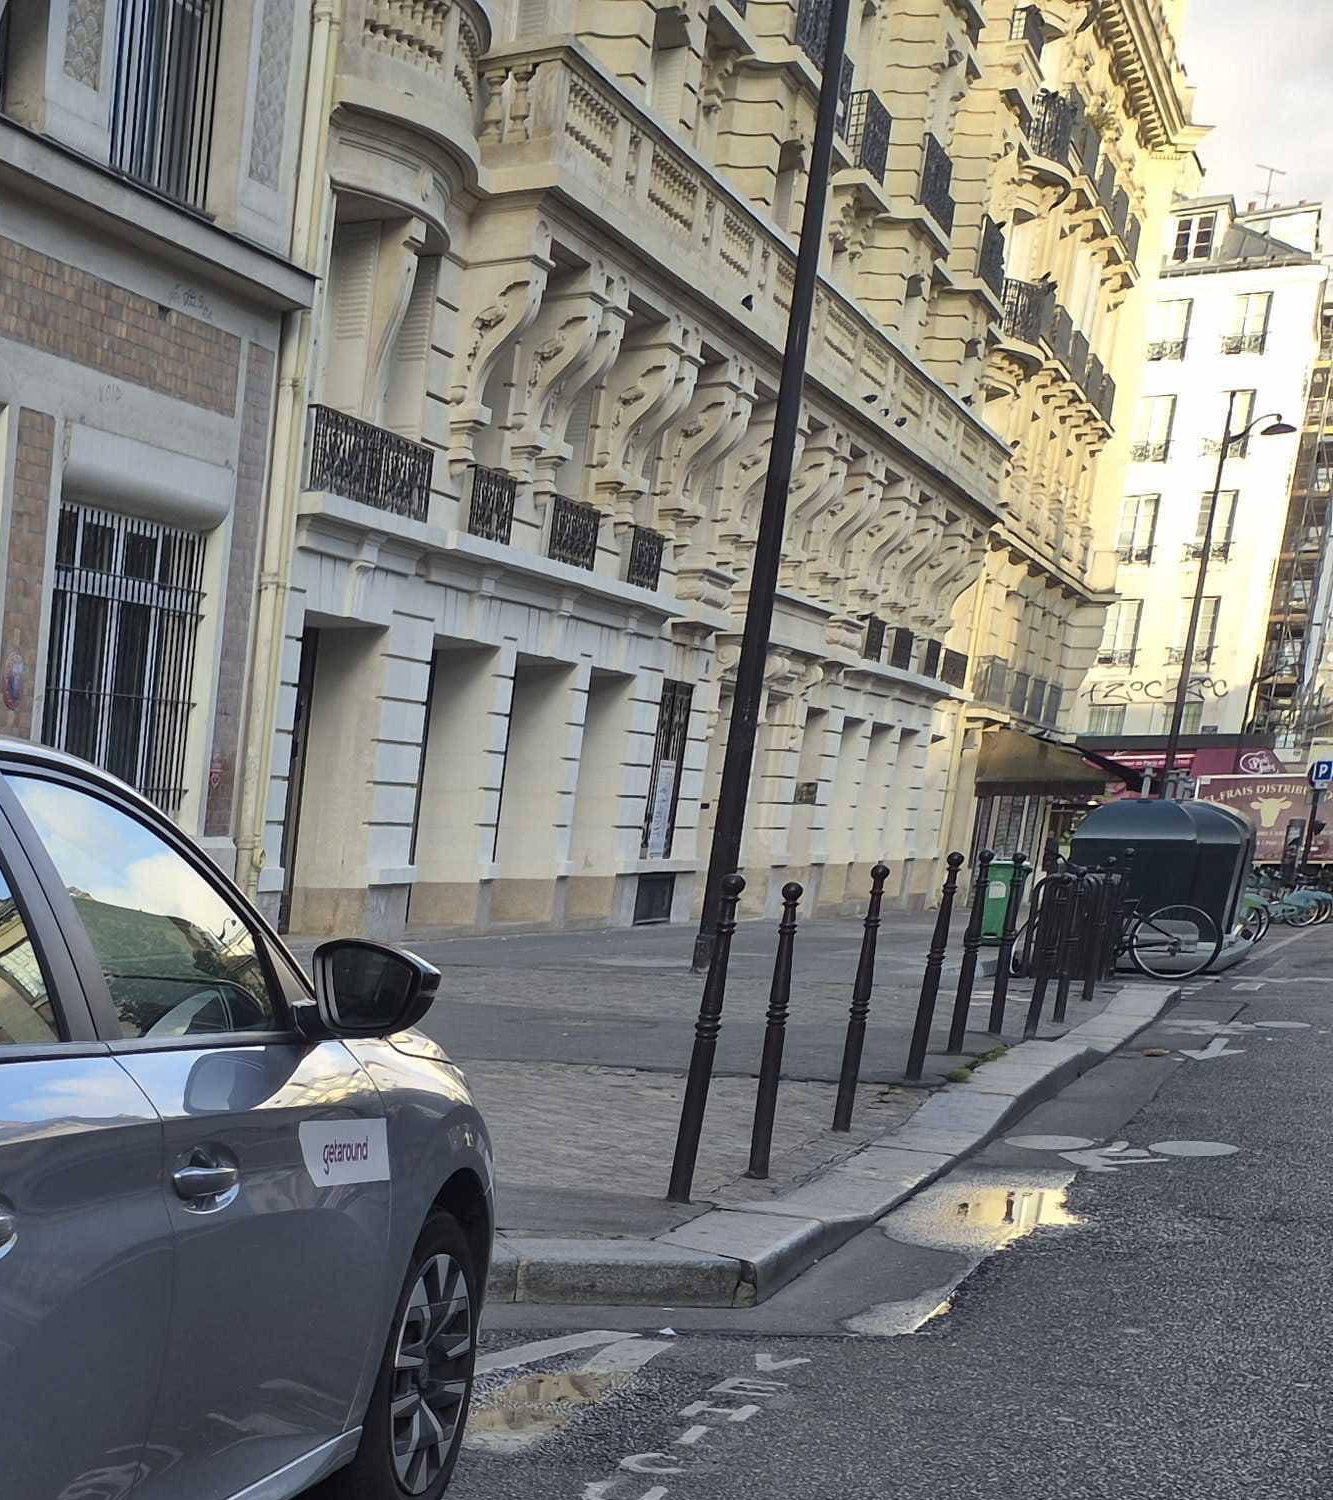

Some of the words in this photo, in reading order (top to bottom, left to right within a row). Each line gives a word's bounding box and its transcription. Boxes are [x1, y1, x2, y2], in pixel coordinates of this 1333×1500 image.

[1318, 763, 1329, 778] P
[1220, 785, 1253, 800] FRAIS
[323, 1136, 369, 1175] getaround
